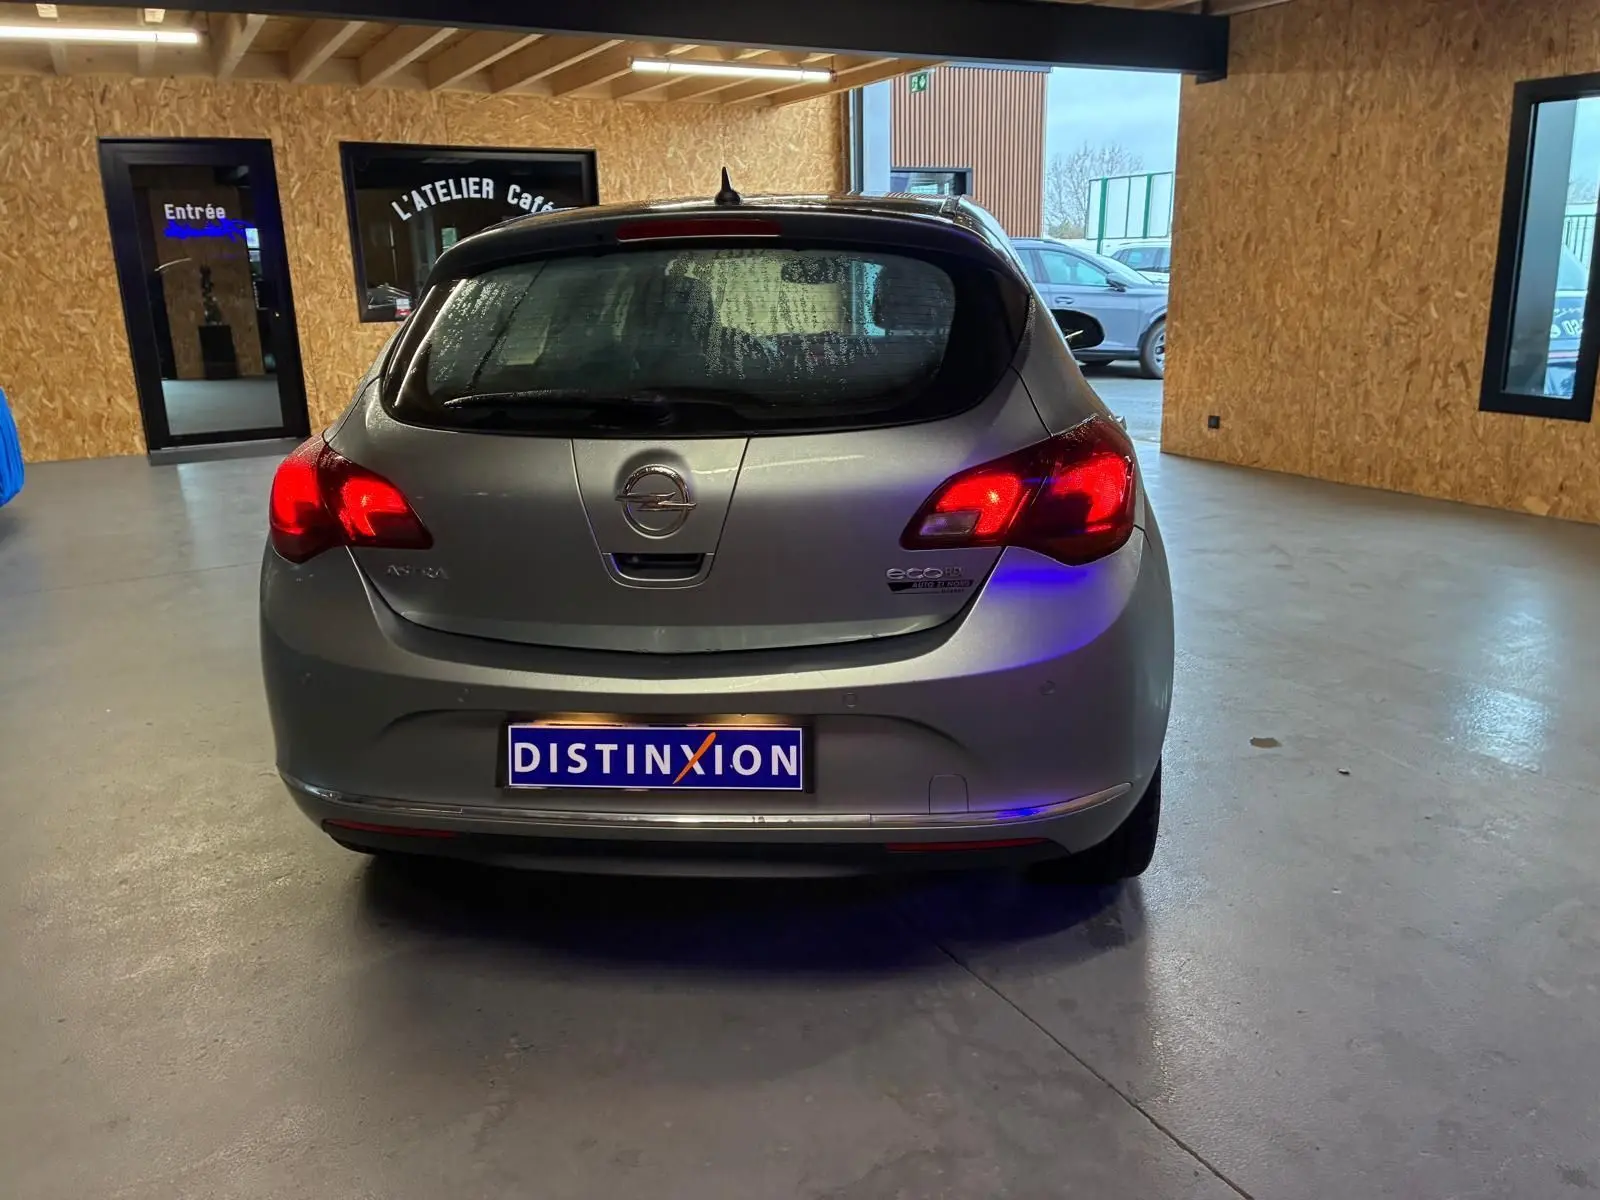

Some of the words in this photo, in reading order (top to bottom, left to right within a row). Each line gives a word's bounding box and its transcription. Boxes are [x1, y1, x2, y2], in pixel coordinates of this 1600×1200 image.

[164, 203, 226, 219] Entrée
[391, 177, 494, 221] L'ATELIER
[513, 735, 798, 781] DISTINXION
